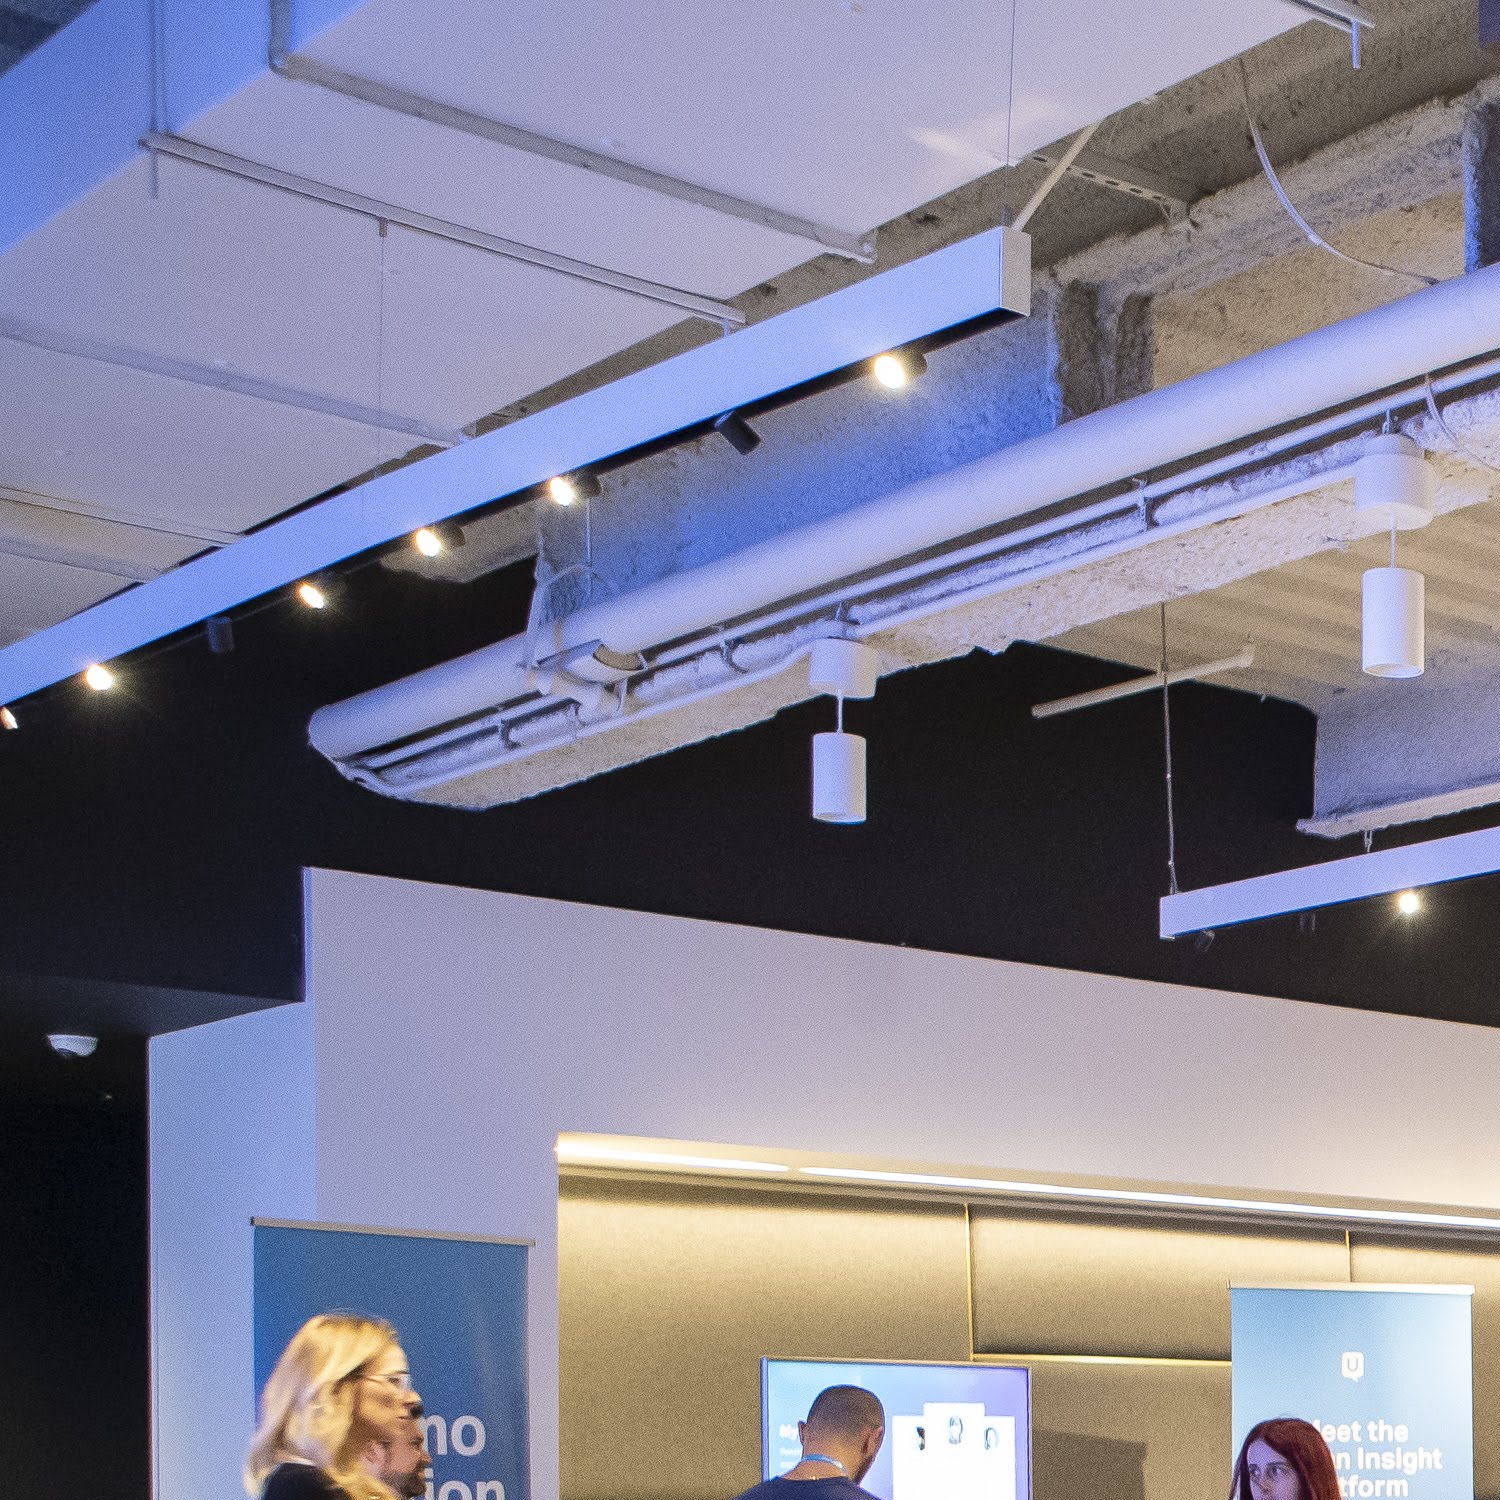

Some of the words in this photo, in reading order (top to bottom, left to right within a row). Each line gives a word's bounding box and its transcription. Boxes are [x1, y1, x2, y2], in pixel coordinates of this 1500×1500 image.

[1367, 1419, 1409, 1442] the
[1357, 1447, 1443, 1475] Insight
[1340, 1474, 1409, 1498] tform
